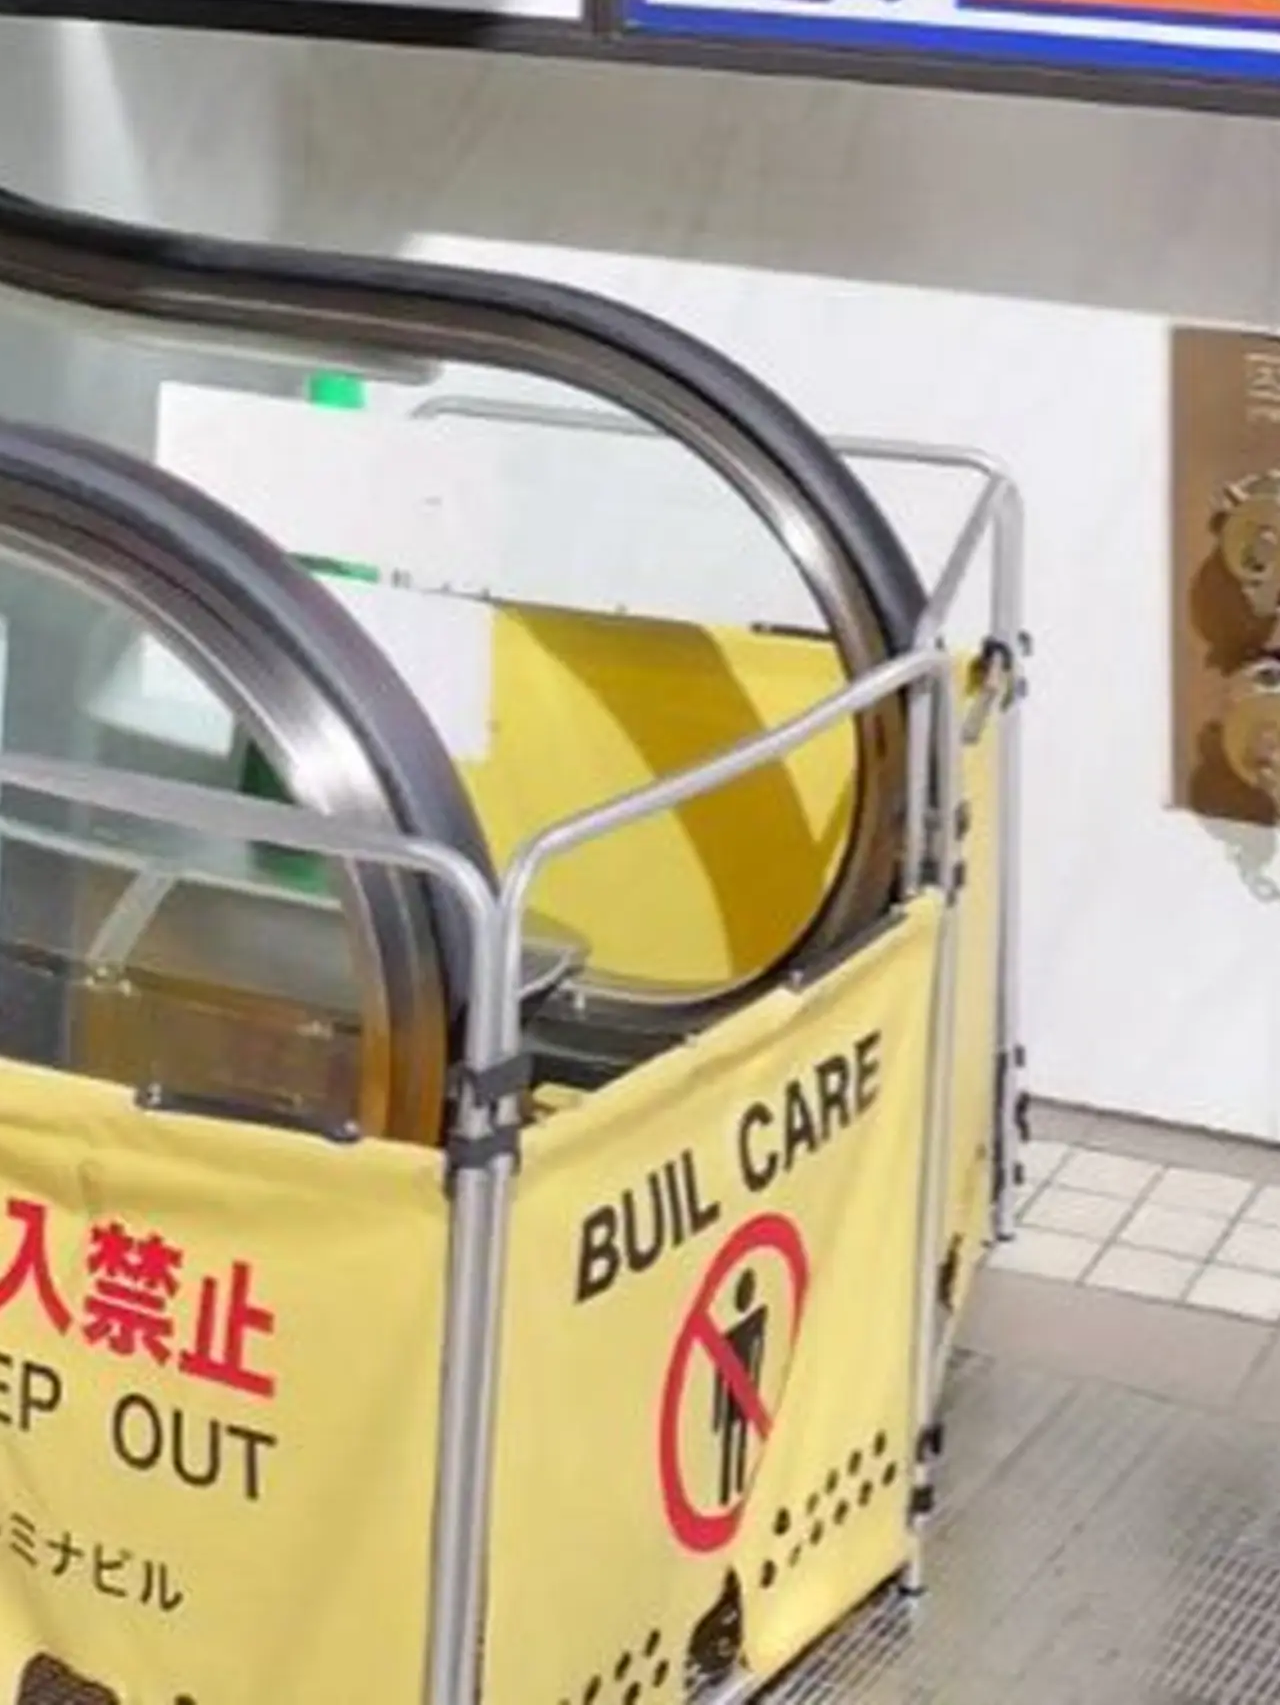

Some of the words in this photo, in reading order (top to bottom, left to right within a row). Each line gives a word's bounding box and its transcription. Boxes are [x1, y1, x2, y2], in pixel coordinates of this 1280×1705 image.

[576, 1151, 720, 1304] BUIL
[736, 1031, 884, 1195] CARE
[113, 1393, 275, 1501] OUT
